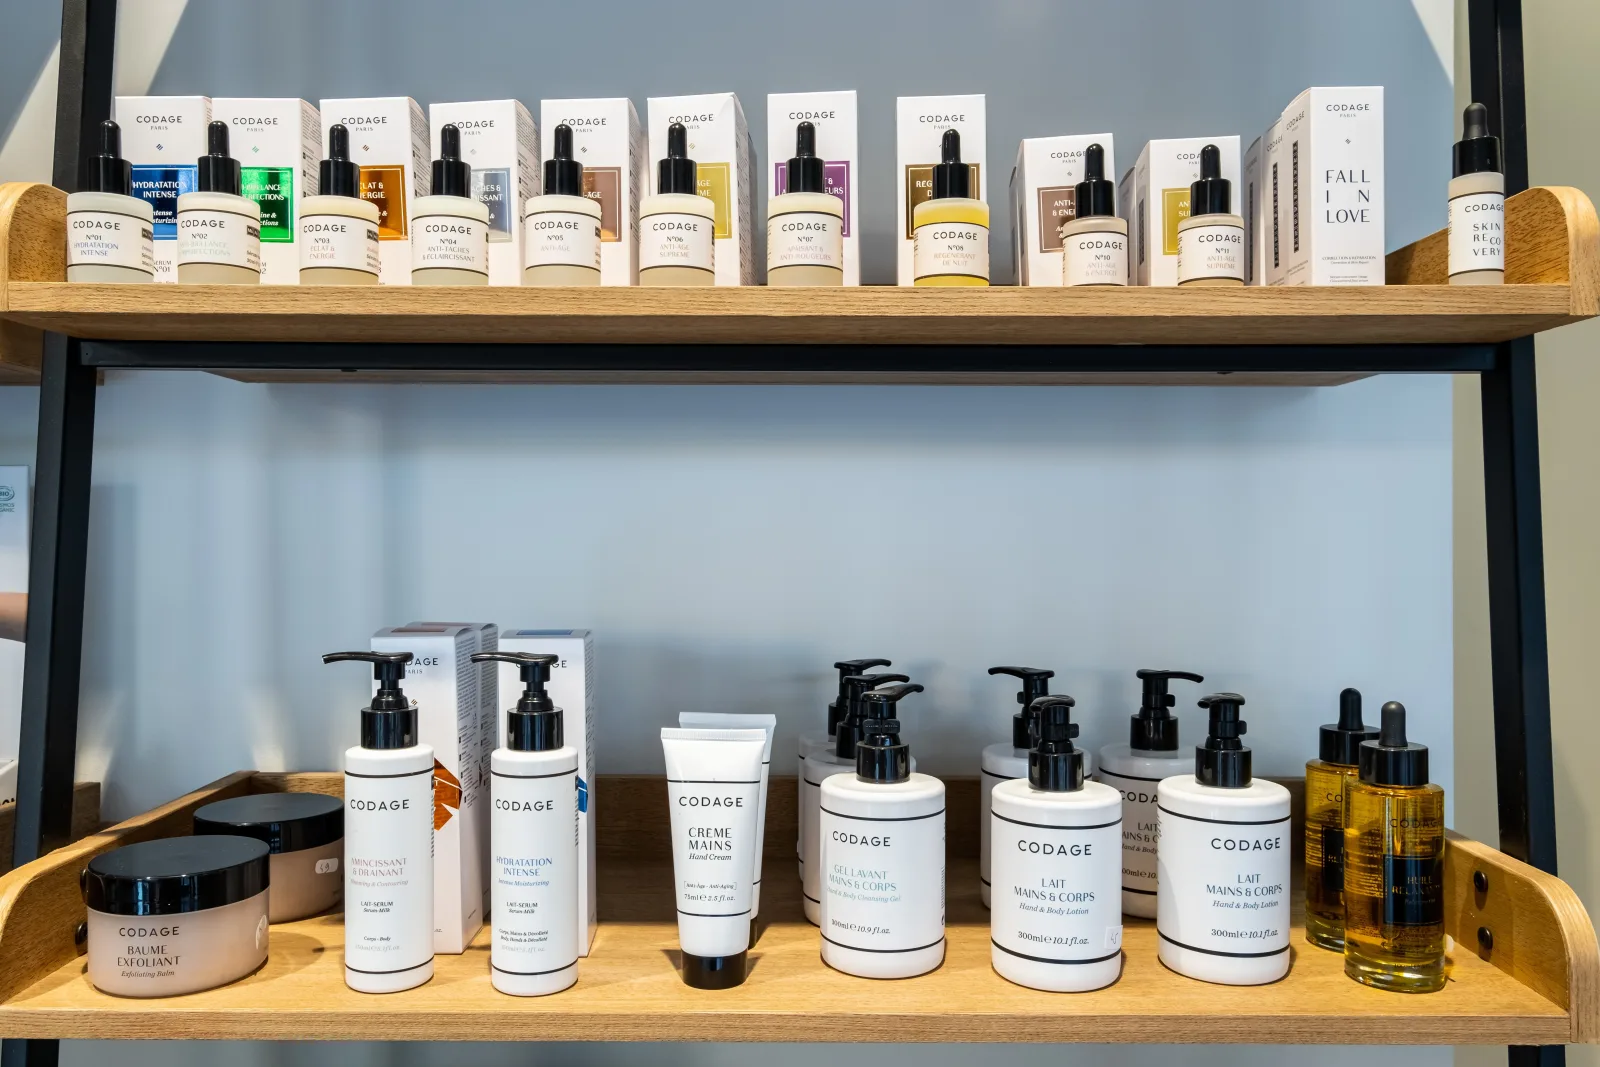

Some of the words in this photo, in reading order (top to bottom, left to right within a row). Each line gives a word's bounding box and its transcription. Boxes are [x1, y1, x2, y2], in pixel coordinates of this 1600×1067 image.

[1326, 104, 1370, 112] CODAGE
[136, 115, 183, 124] CODAGE
[669, 114, 714, 123] CODAGE
[789, 111, 835, 120] CODAGE
[919, 114, 965, 123] CODAGE
[1286, 110, 1305, 130] CODAGE
[341, 117, 387, 125] CODAGE
[562, 118, 607, 126] CODAGE
[1326, 169, 1371, 184] FALL
[133, 181, 187, 189] HYDRATATION
[143, 190, 177, 198] INTENSE
[1326, 209, 1371, 224] LOVE
[73, 221, 121, 231] CODAGE
[181, 220, 225, 229] CODAGE
[303, 224, 347, 233] CODAGE
[534, 221, 579, 230] CODAGE
[653, 222, 698, 231] CODAGE
[782, 222, 827, 232] CODAGE
[1473, 223, 1501, 232] SKIN
[426, 225, 472, 235] CODAGE
[933, 231, 978, 241] CODAGE
[1198, 234, 1241, 244] CODAGE
[74, 242, 119, 250] HYDRATATION
[427, 246, 470, 254] ANTI-TACHES
[1080, 241, 1123, 250] CODAGE
[1473, 248, 1501, 256] VERY
[350, 799, 410, 811] CODAGE
[496, 799, 554, 811] CODAGE
[679, 796, 743, 808] CODAGE
[1138, 822, 1158, 832] LAIT
[688, 827, 732, 839] CREME
[1122, 831, 1142, 842] AINS
[1144, 835, 1150, 843] &
[832, 830, 891, 847] CODAGE
[689, 840, 732, 851] MAINS
[1018, 839, 1092, 857] CODAGE
[1122, 843, 1135, 851] and
[1142, 847, 1158, 855] Body
[1211, 837, 1281, 851] CODAGE
[496, 856, 553, 867] HYDRATATION
[358, 868, 403, 877] DRAINANT
[503, 867, 540, 877] INTENSE
[834, 864, 849, 876] GEL
[851, 868, 888, 881] LAVANT
[1122, 868, 1140, 877] 00ml
[498, 878, 513, 886] Intense
[829, 873, 853, 888] MAINS
[854, 880, 860, 890] &
[862, 881, 897, 892] CORPS
[1041, 878, 1066, 889] LAIT
[1237, 873, 1261, 884] LAIT
[1014, 885, 1047, 901] MAINS
[1049, 892, 1056, 902] &
[1058, 892, 1095, 903] CORPS
[1206, 884, 1243, 897] MAINS
[1245, 888, 1252, 897] &
[1254, 883, 1283, 897] CORPS
[684, 893, 699, 901] 75ml
[842, 891, 857, 901] Body
[857, 894, 889, 903] Cleansing
[890, 895, 902, 903] Gel
[1019, 902, 1039, 912] Hand
[1046, 906, 1066, 916] Body
[1066, 907, 1089, 915] Lotion
[1212, 900, 1234, 909] Hand
[1242, 902, 1260, 910] Body
[1260, 900, 1279, 909] Lotion
[119, 926, 180, 938] CODAGE
[1211, 928, 1239, 939] 300ml
[1018, 931, 1044, 943] 300ml
[1053, 937, 1069, 945] 10.1
[127, 945, 168, 955] BAUME
[117, 955, 181, 968] EXFOLIANT
[121, 970, 156, 979] Exfoliating
